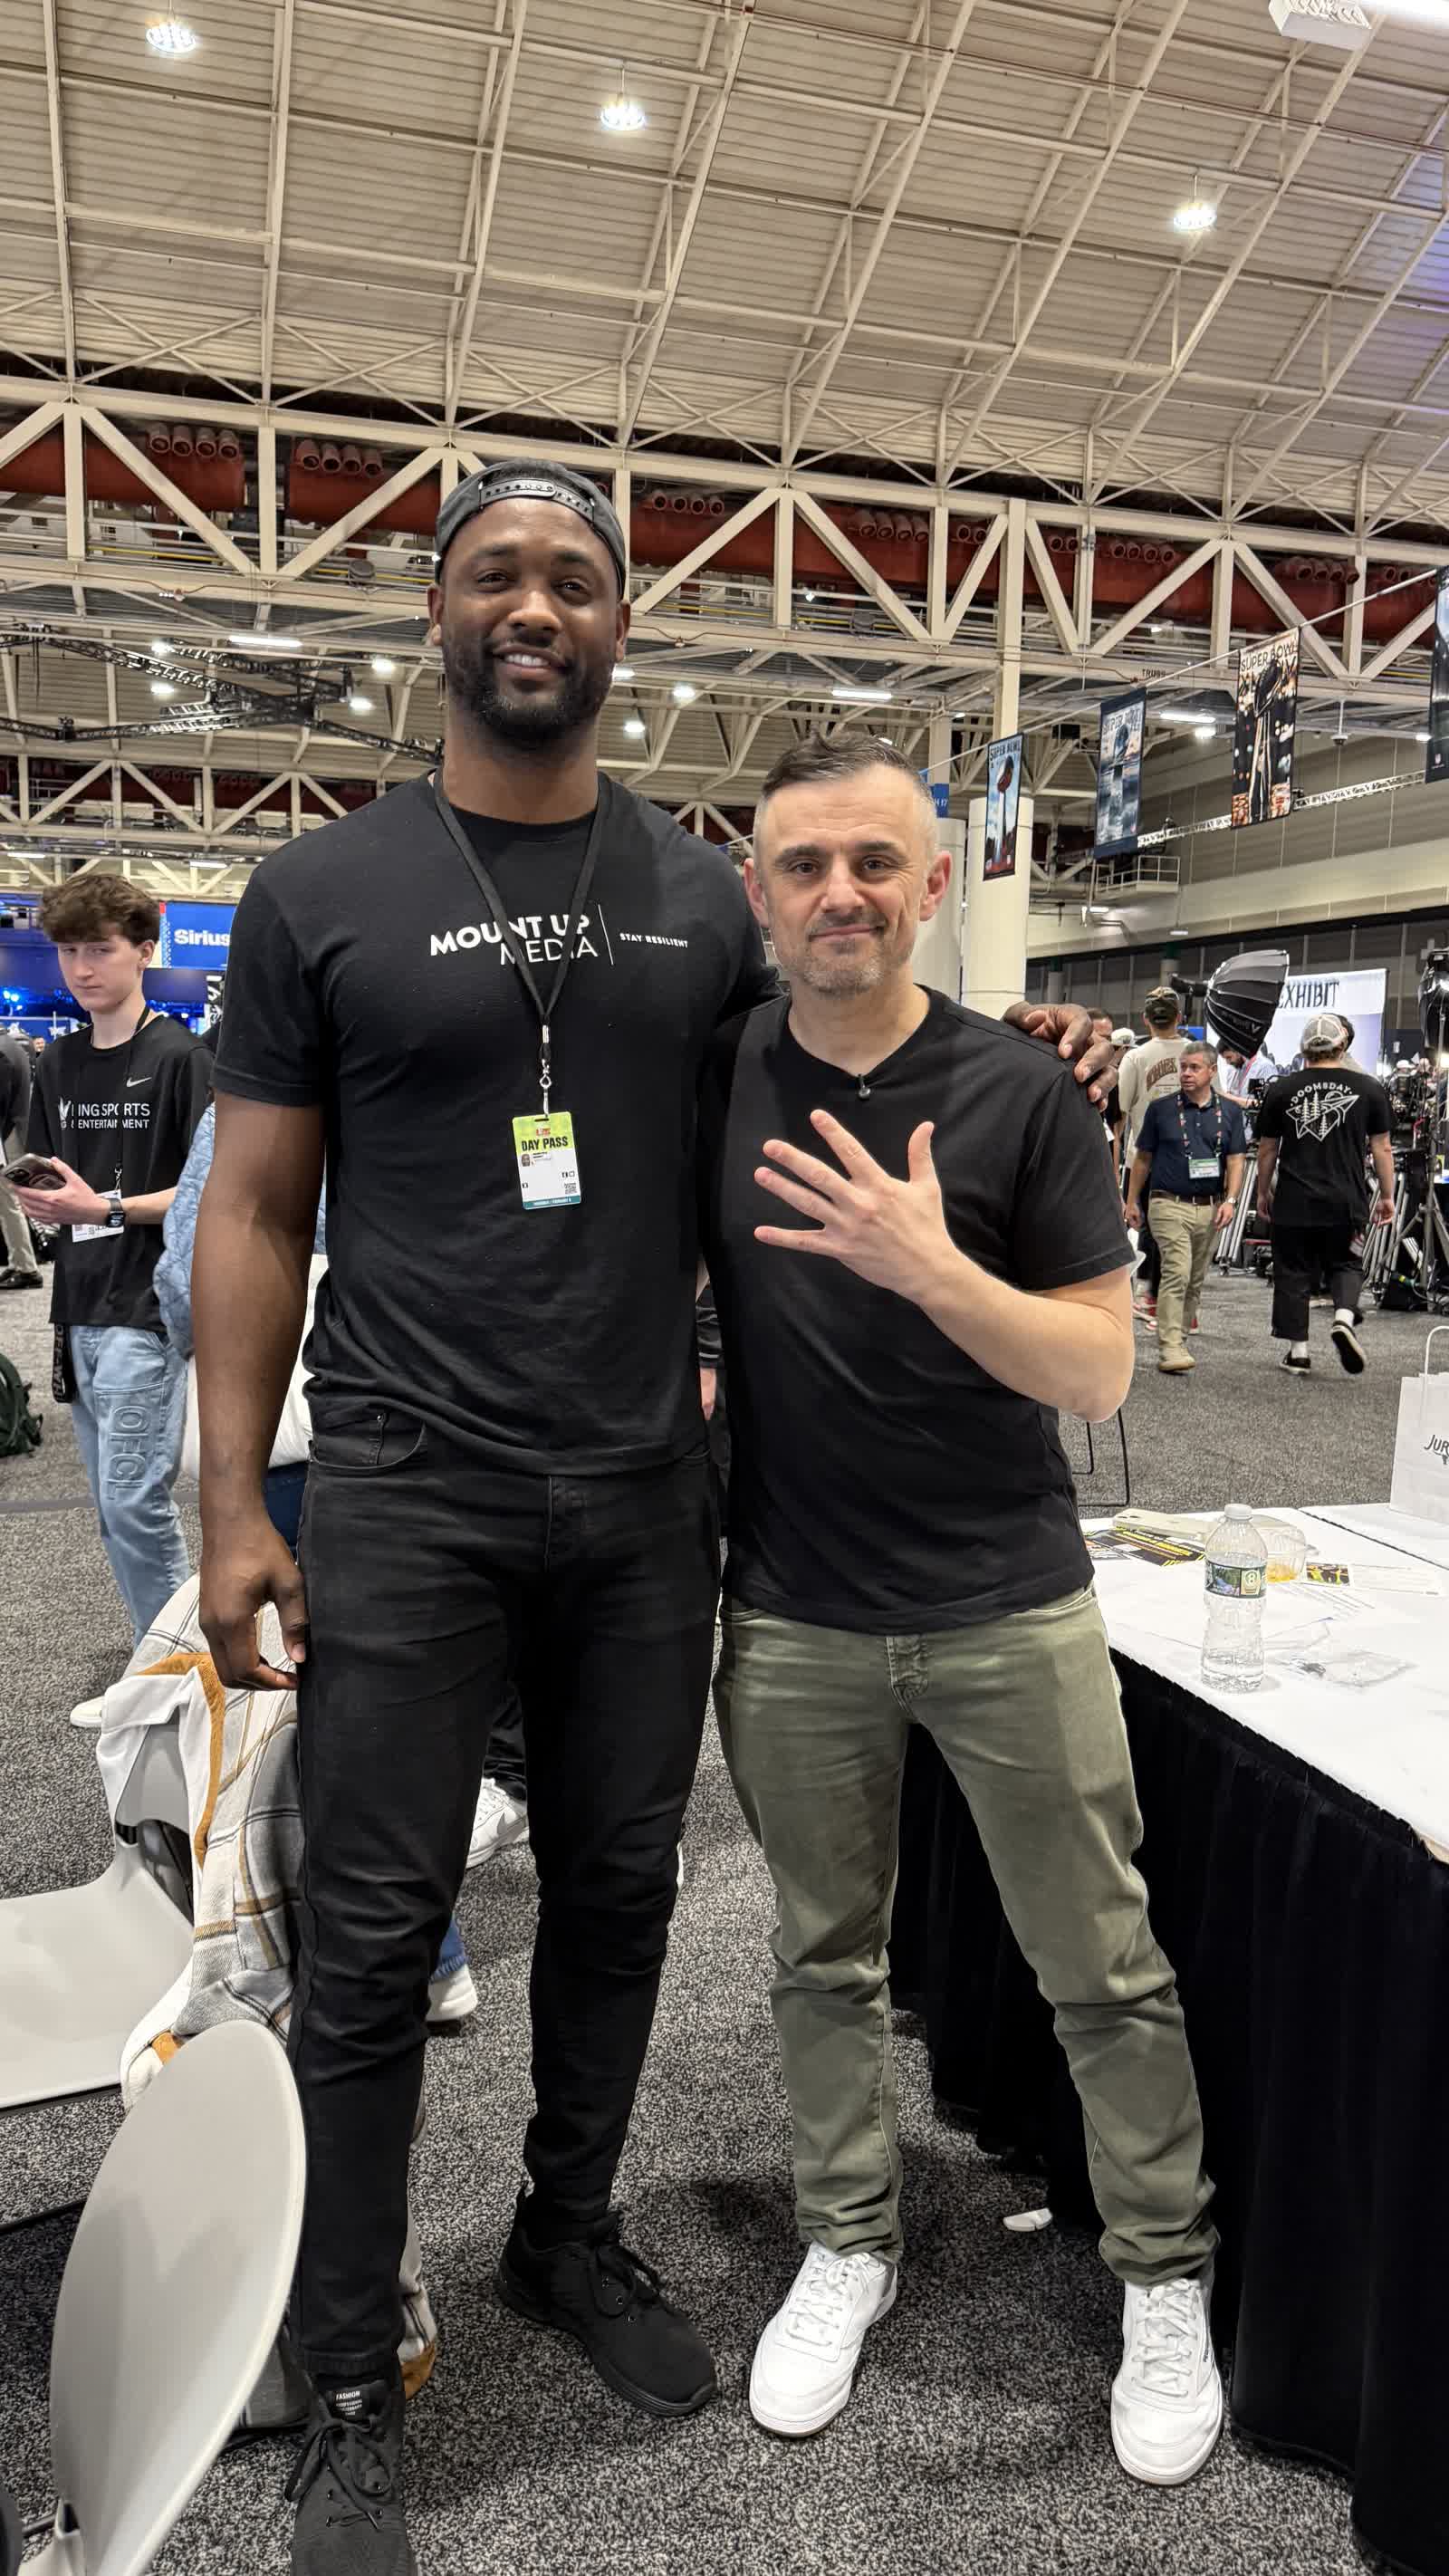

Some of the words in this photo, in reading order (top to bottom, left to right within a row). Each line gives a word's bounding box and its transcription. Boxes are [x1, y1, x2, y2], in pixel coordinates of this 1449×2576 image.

[1242, 651, 1268, 672] SUPER
[174, 928, 231, 947] Sirius
[430, 915, 542, 956] MOUNT
[619, 932, 644, 942] STAY
[646, 935, 689, 949] RESILIENT
[500, 937, 599, 966] MEDA
[1278, 980, 1339, 1009] XHIBIT
[1291, 1081, 1350, 1104] DOOMSDAY
[522, 1139, 540, 1152] DAY
[542, 1136, 569, 1149] PASS
